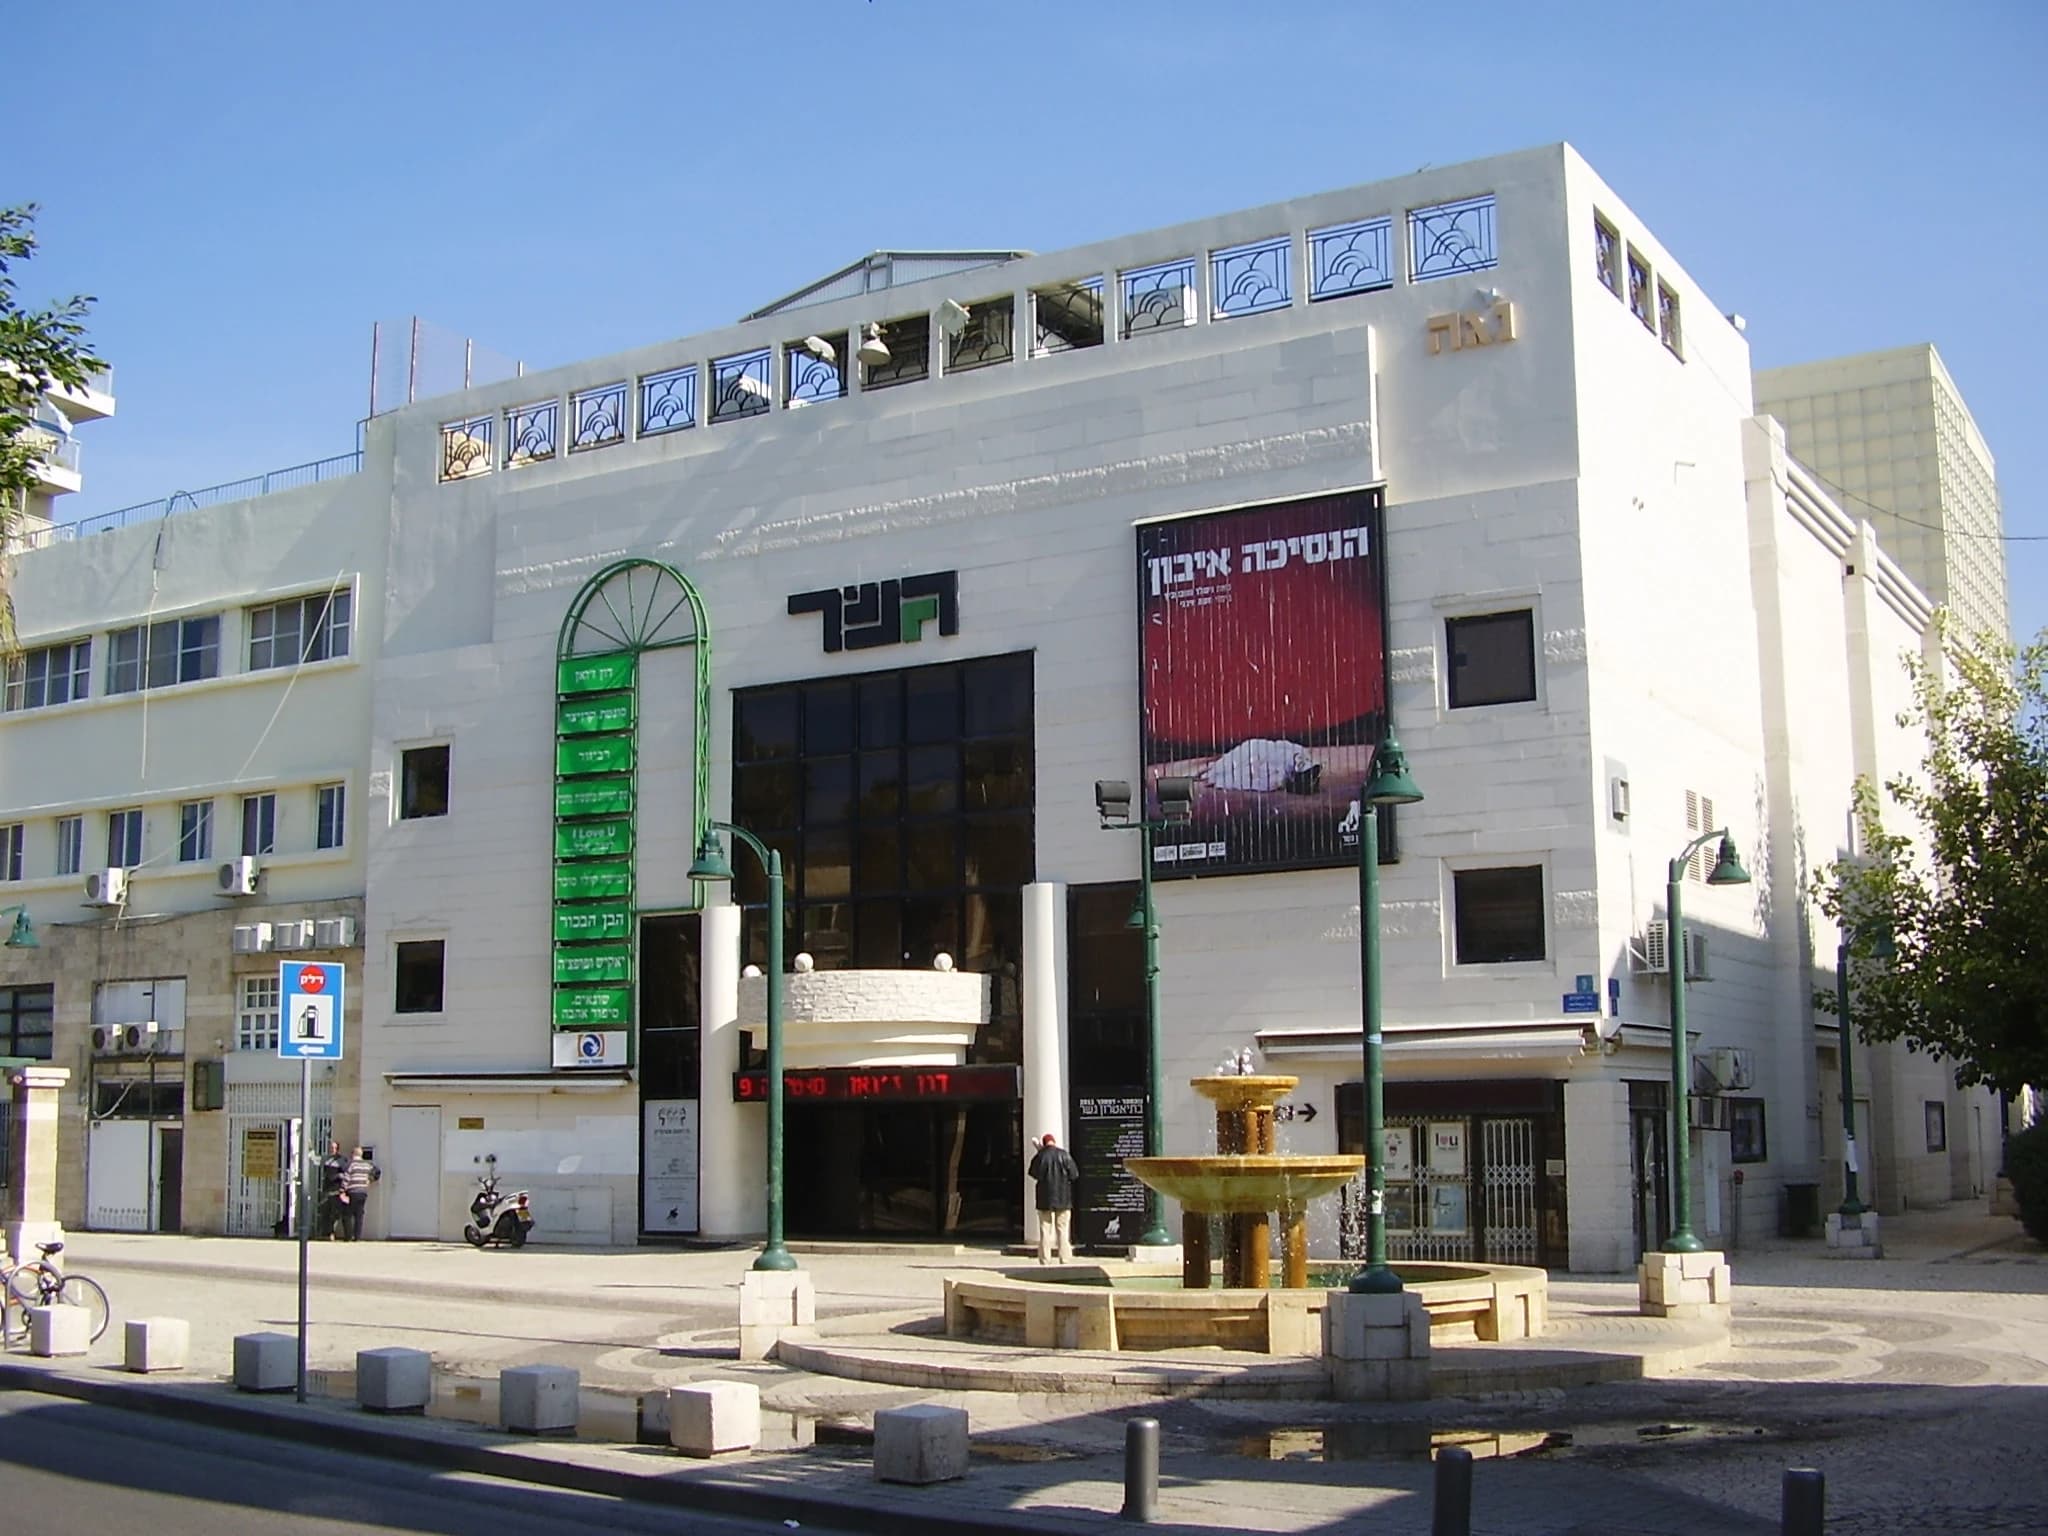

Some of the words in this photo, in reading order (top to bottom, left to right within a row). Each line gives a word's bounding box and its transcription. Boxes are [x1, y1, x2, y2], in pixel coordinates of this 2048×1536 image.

[1242, 526, 1369, 573] הנסיכה
[1148, 547, 1233, 597] איבון
[599, 668, 613, 681] דון
[579, 828, 605, 839] Love
[607, 825, 616, 837] U
[559, 915, 597, 929] הבכור
[602, 913, 624, 931] הבן
[300, 974, 324, 985] דלק
[561, 1009, 589, 1020] אהבה
[590, 1008, 619, 1019] סיפור
[1079, 1105, 1098, 1115] גשר
[1100, 1104, 1144, 1117] בתיאטרון
